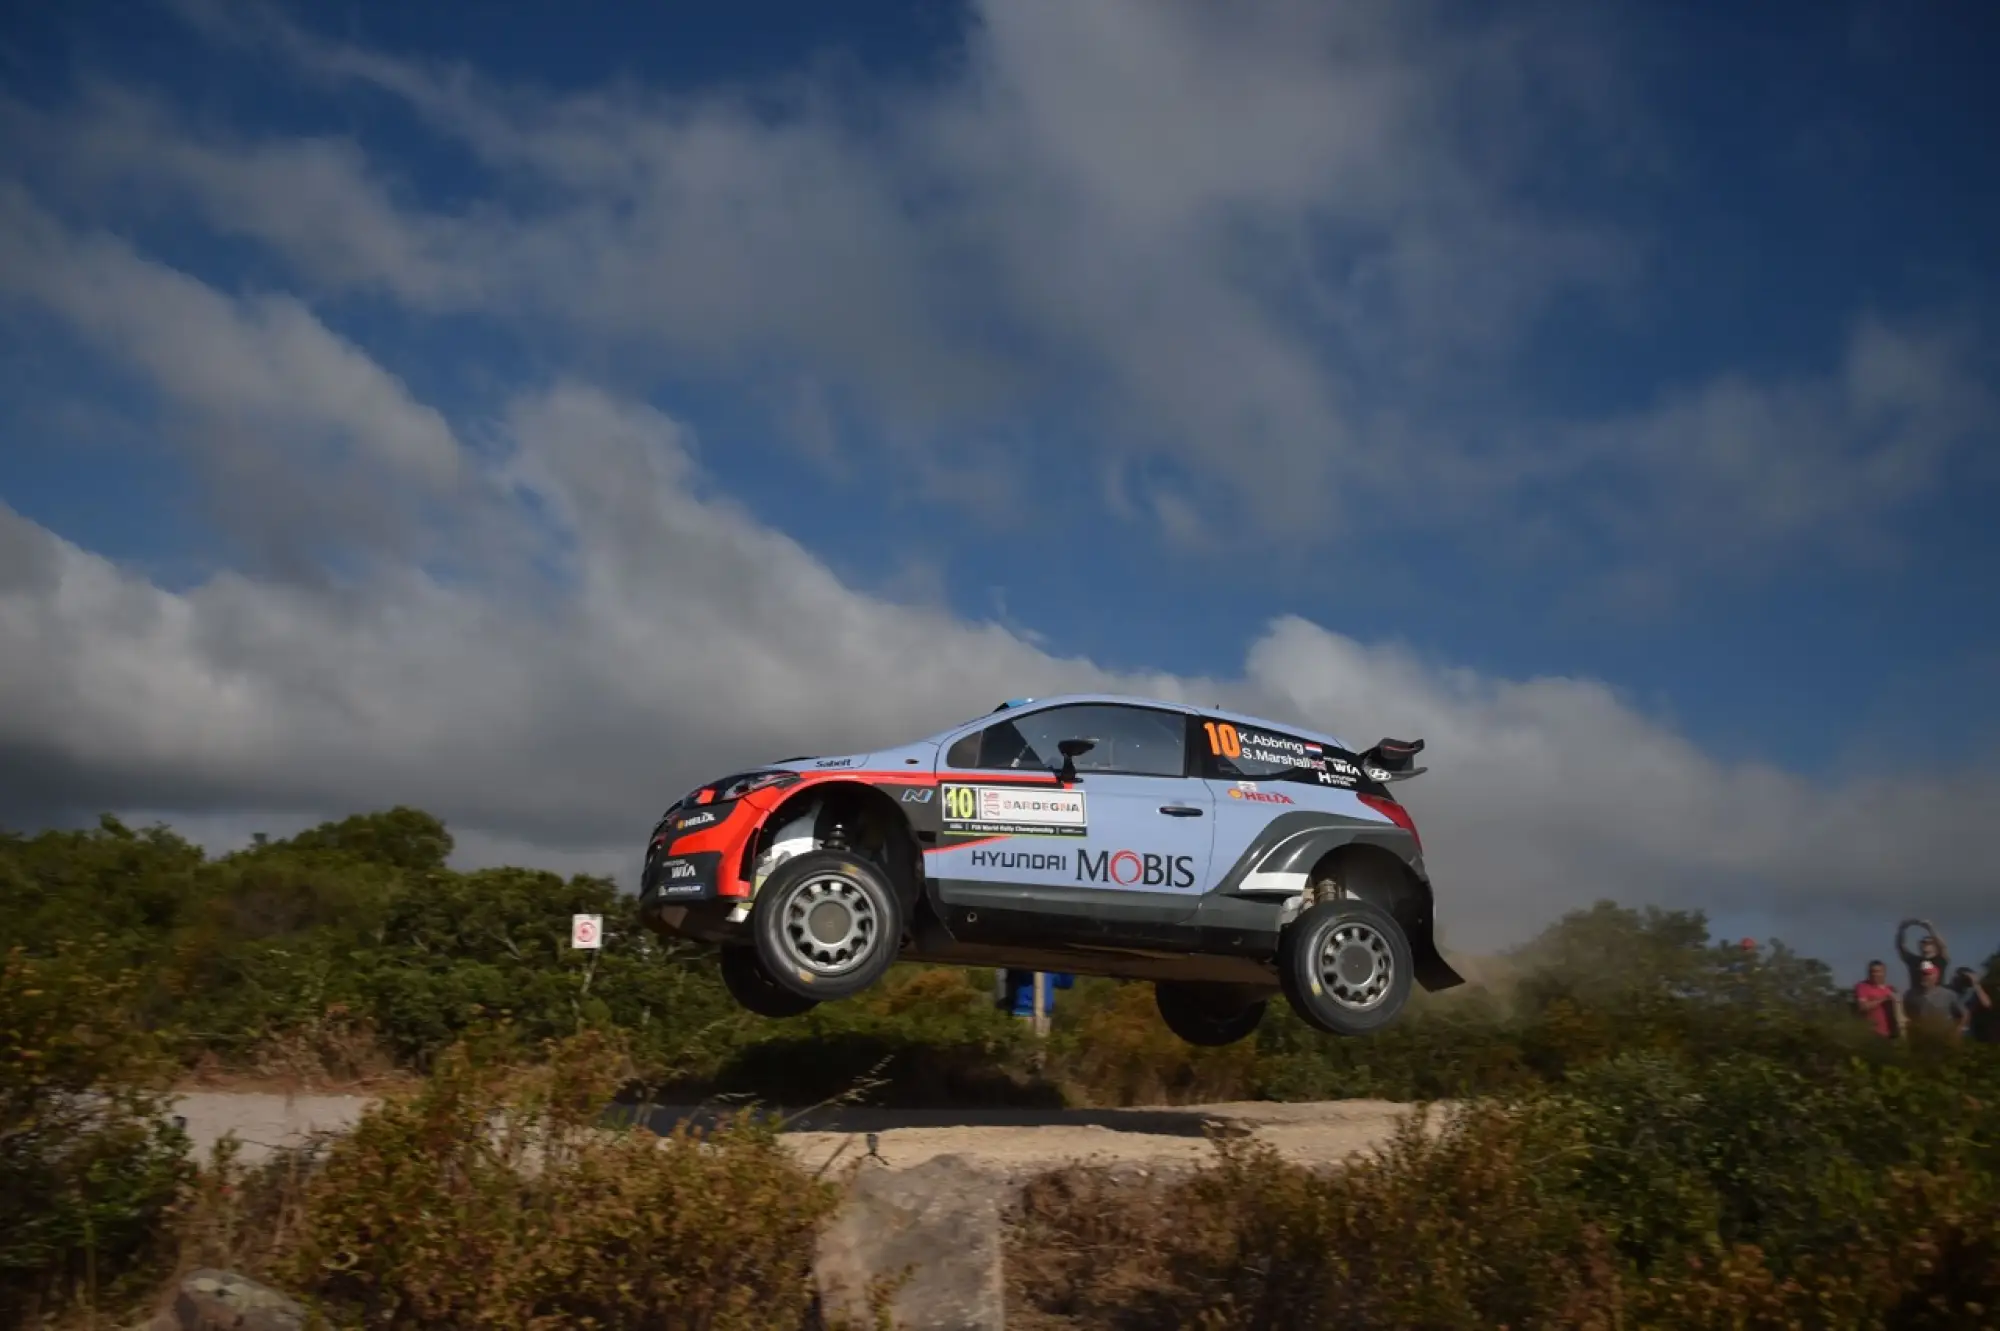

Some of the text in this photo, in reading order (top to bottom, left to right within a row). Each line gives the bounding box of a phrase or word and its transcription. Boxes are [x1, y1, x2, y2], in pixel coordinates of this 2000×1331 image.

[1204, 722, 1241, 758] 10
[1238, 732, 1304, 755] K.Abbring
[815, 759, 852, 768] Sabelt
[1241, 747, 1311, 768] S.Marshall
[946, 787, 973, 818] 10
[1003, 800, 1080, 812] SARDEGNA
[1244, 792, 1295, 804] HELIX
[684, 812, 715, 827] HELIX
[983, 824, 999, 832] World
[1000, 825, 1014, 833] Rally
[1015, 825, 1055, 834] Championship
[971, 849, 1195, 889] HYUNDAI MOBIS
